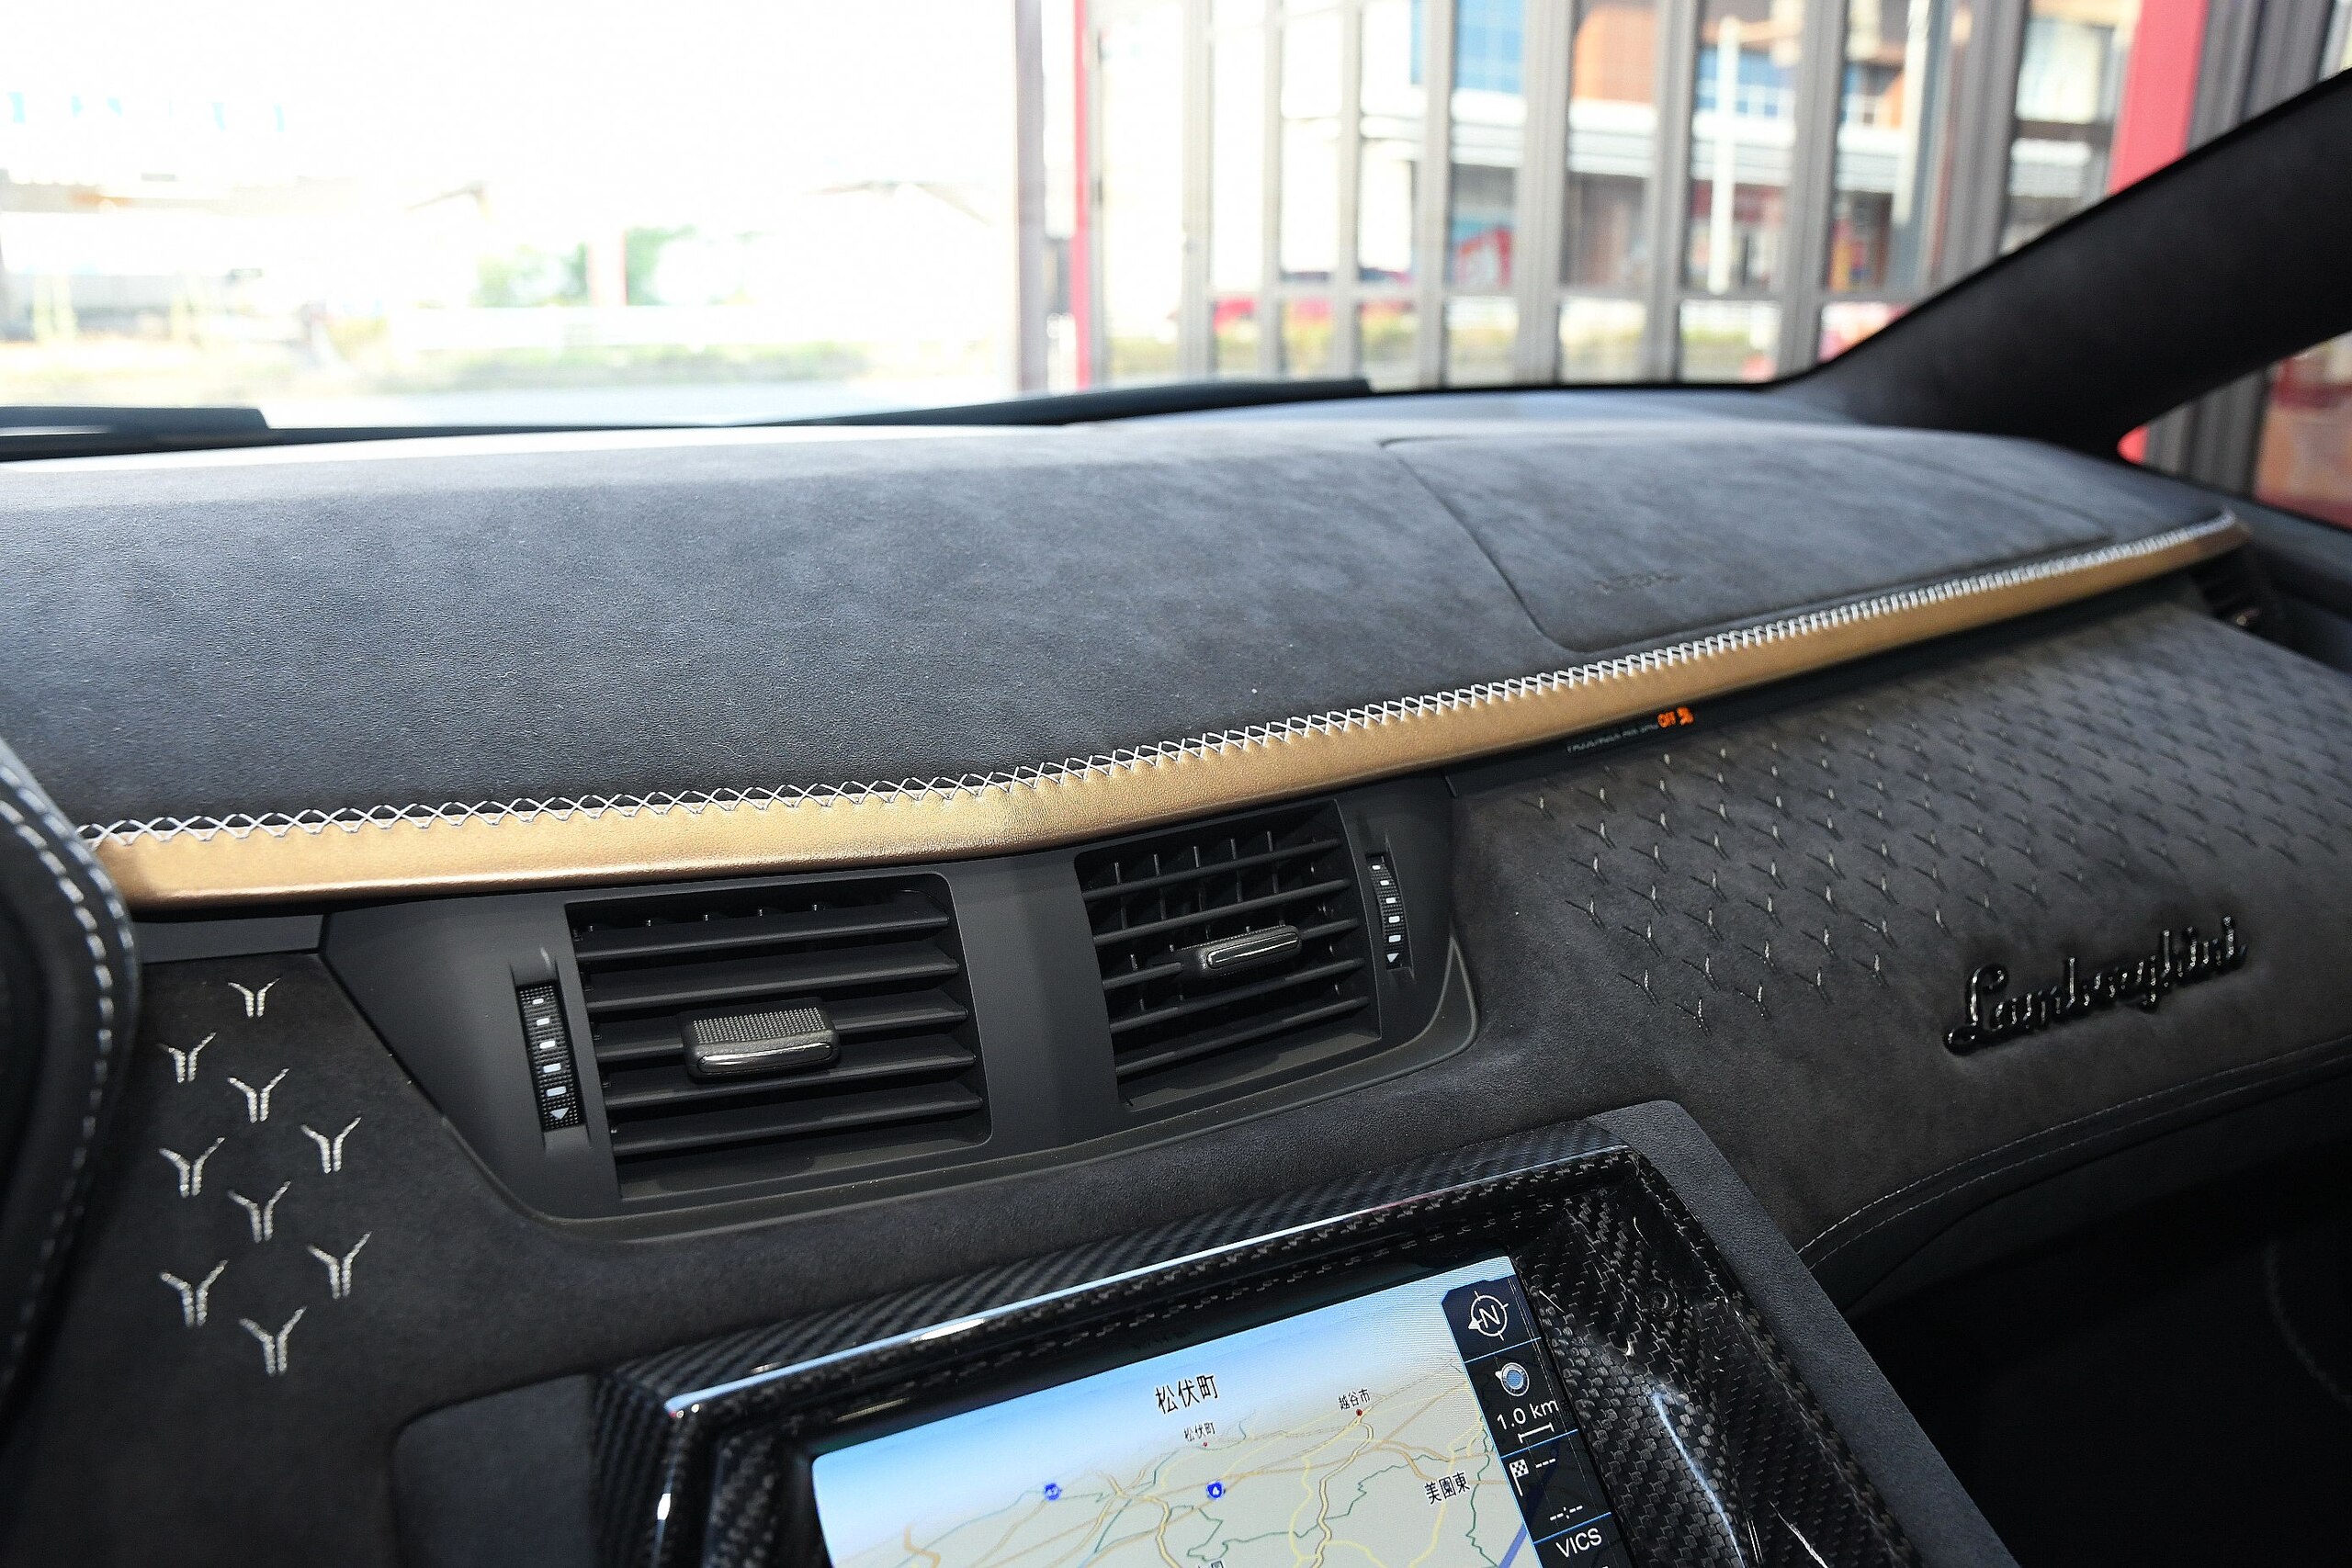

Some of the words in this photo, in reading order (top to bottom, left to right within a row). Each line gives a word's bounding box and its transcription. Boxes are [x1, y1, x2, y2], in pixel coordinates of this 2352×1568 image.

[1942, 914, 2247, 1055] Lamborghini
[1478, 1304, 1501, 1329] N
[1155, 1374, 1218, 1415] 松伏町
[1338, 1388, 1370, 1411] 越谷市
[1497, 1407, 1527, 1430] 1.0
[1529, 1400, 1559, 1419] km
[1183, 1422, 1216, 1442] 松伏町
[1424, 1472, 1471, 1505] 美園東
[1555, 1528, 1602, 1558] VICS
